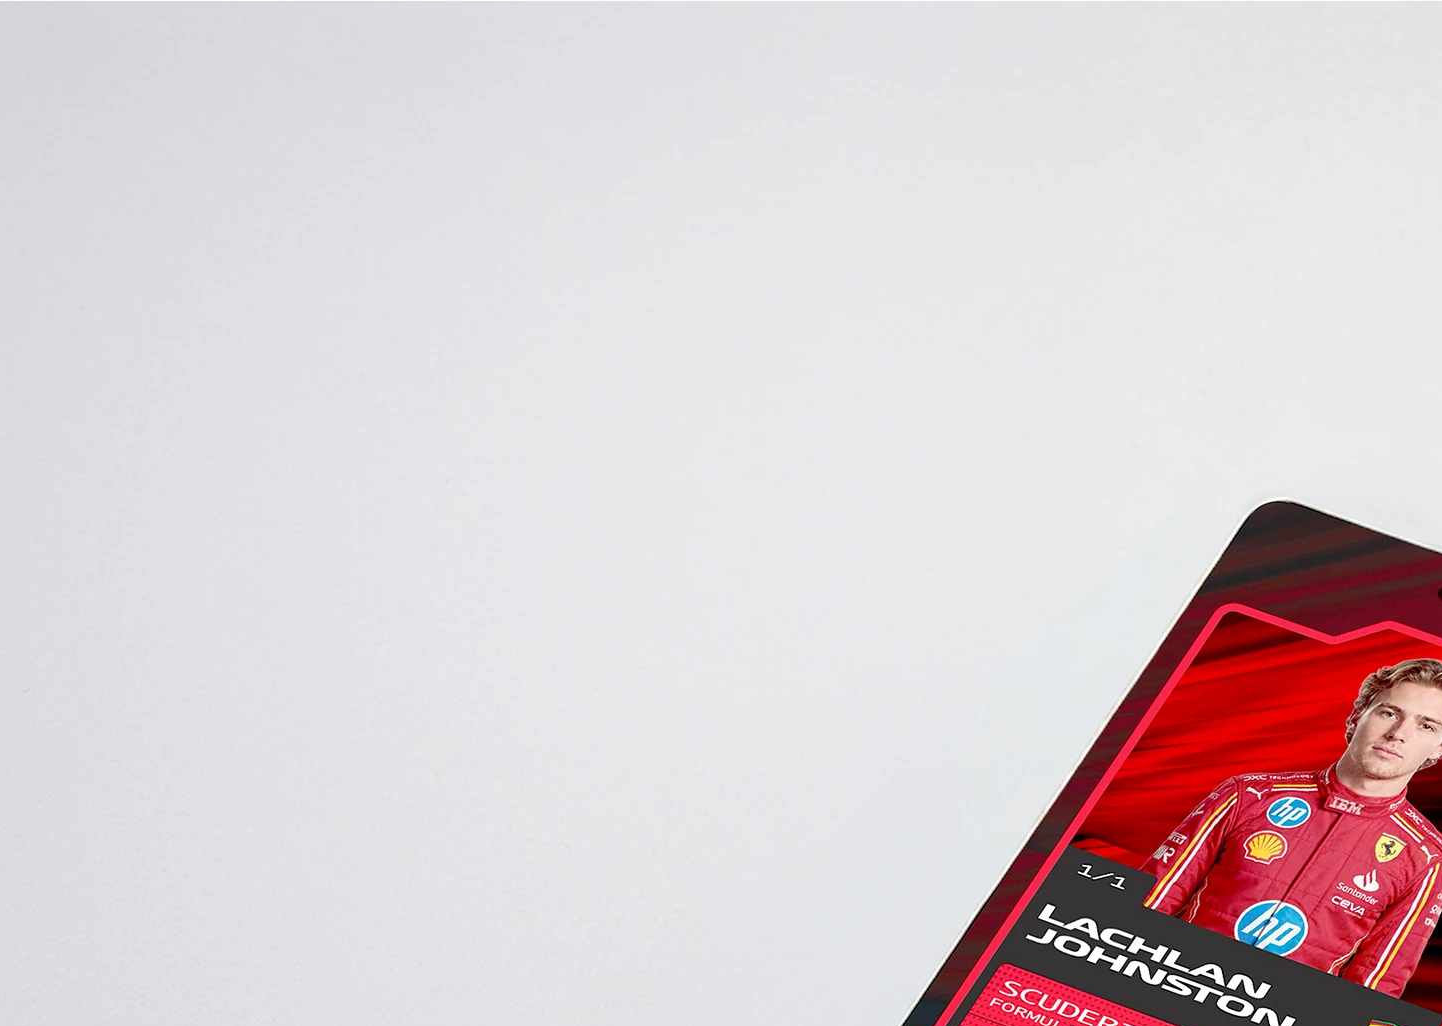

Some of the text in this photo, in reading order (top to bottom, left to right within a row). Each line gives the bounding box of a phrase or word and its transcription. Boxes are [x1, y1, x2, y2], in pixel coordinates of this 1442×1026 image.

[1329, 796, 1365, 815] IBM
[1077, 863, 1126, 890] 1/1
[1336, 881, 1378, 905] Santander
[1038, 903, 1272, 1000] LACHLAN
